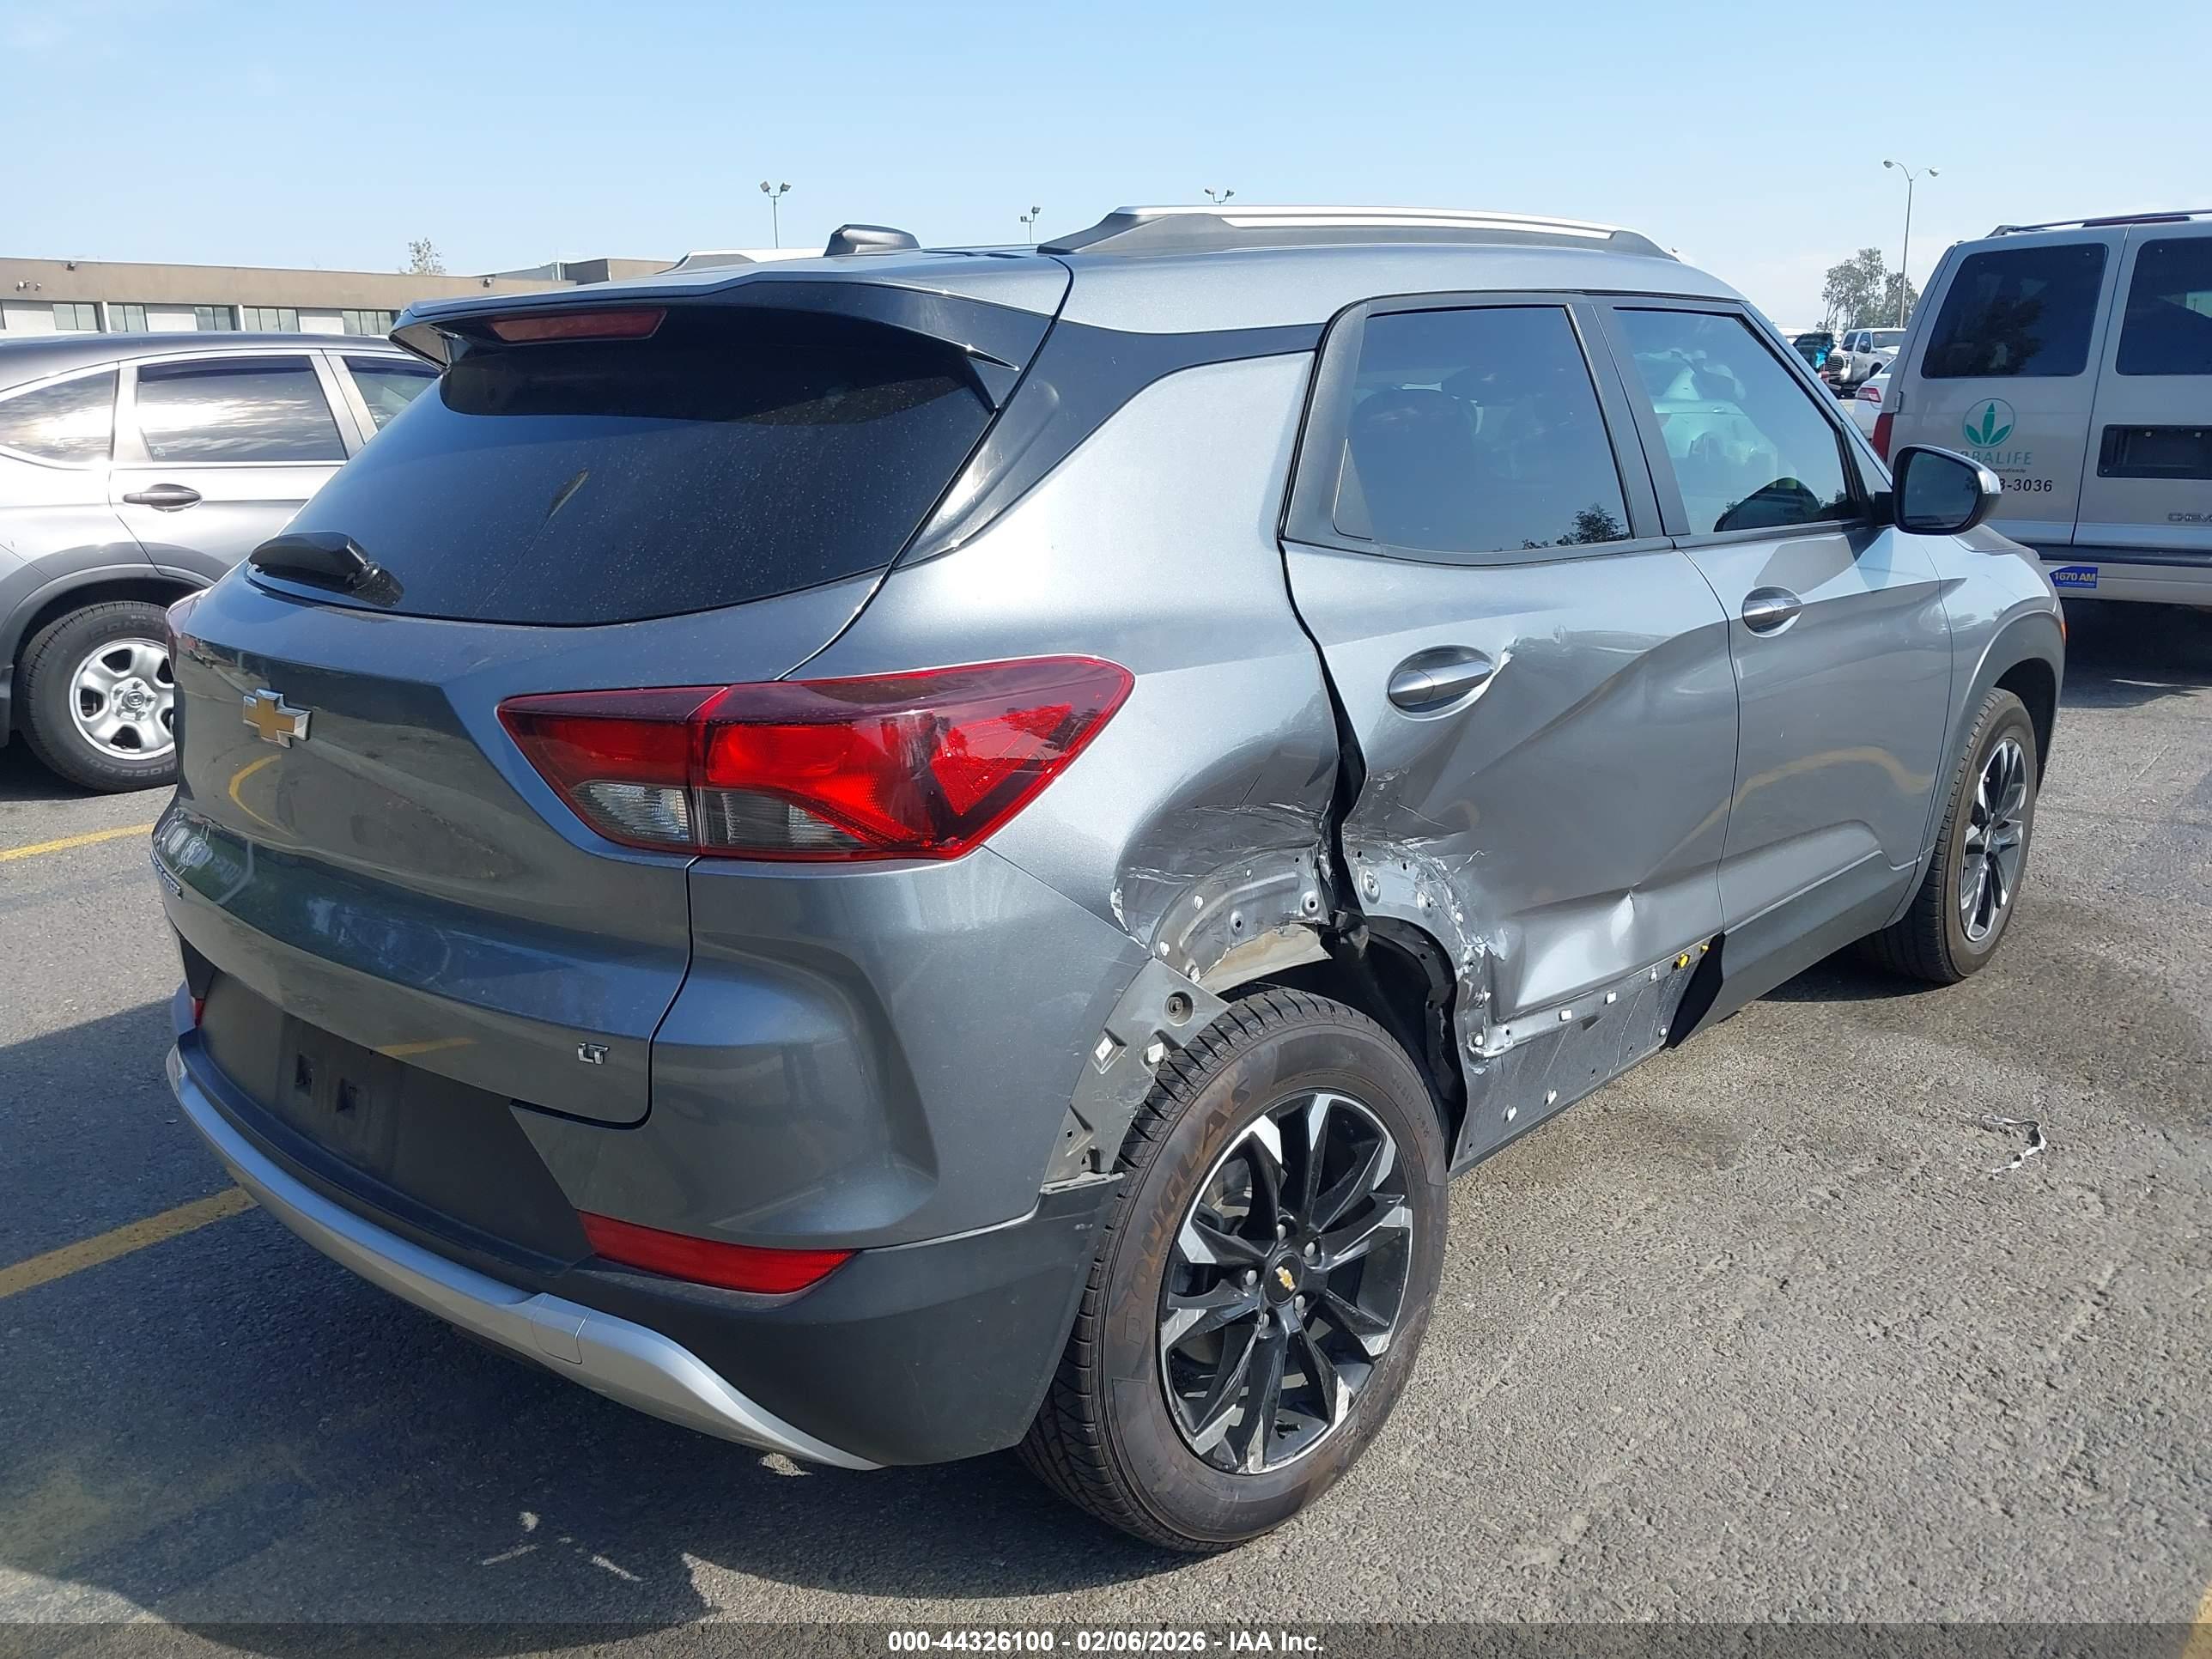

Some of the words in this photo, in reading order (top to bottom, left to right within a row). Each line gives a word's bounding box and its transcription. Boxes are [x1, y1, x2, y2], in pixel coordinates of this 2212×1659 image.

[2054, 572, 2077, 581] 1670
[2078, 573, 2096, 582] AM
[578, 1042, 610, 1065] LT
[1125, 1078, 1252, 1345] DOUGLAS
